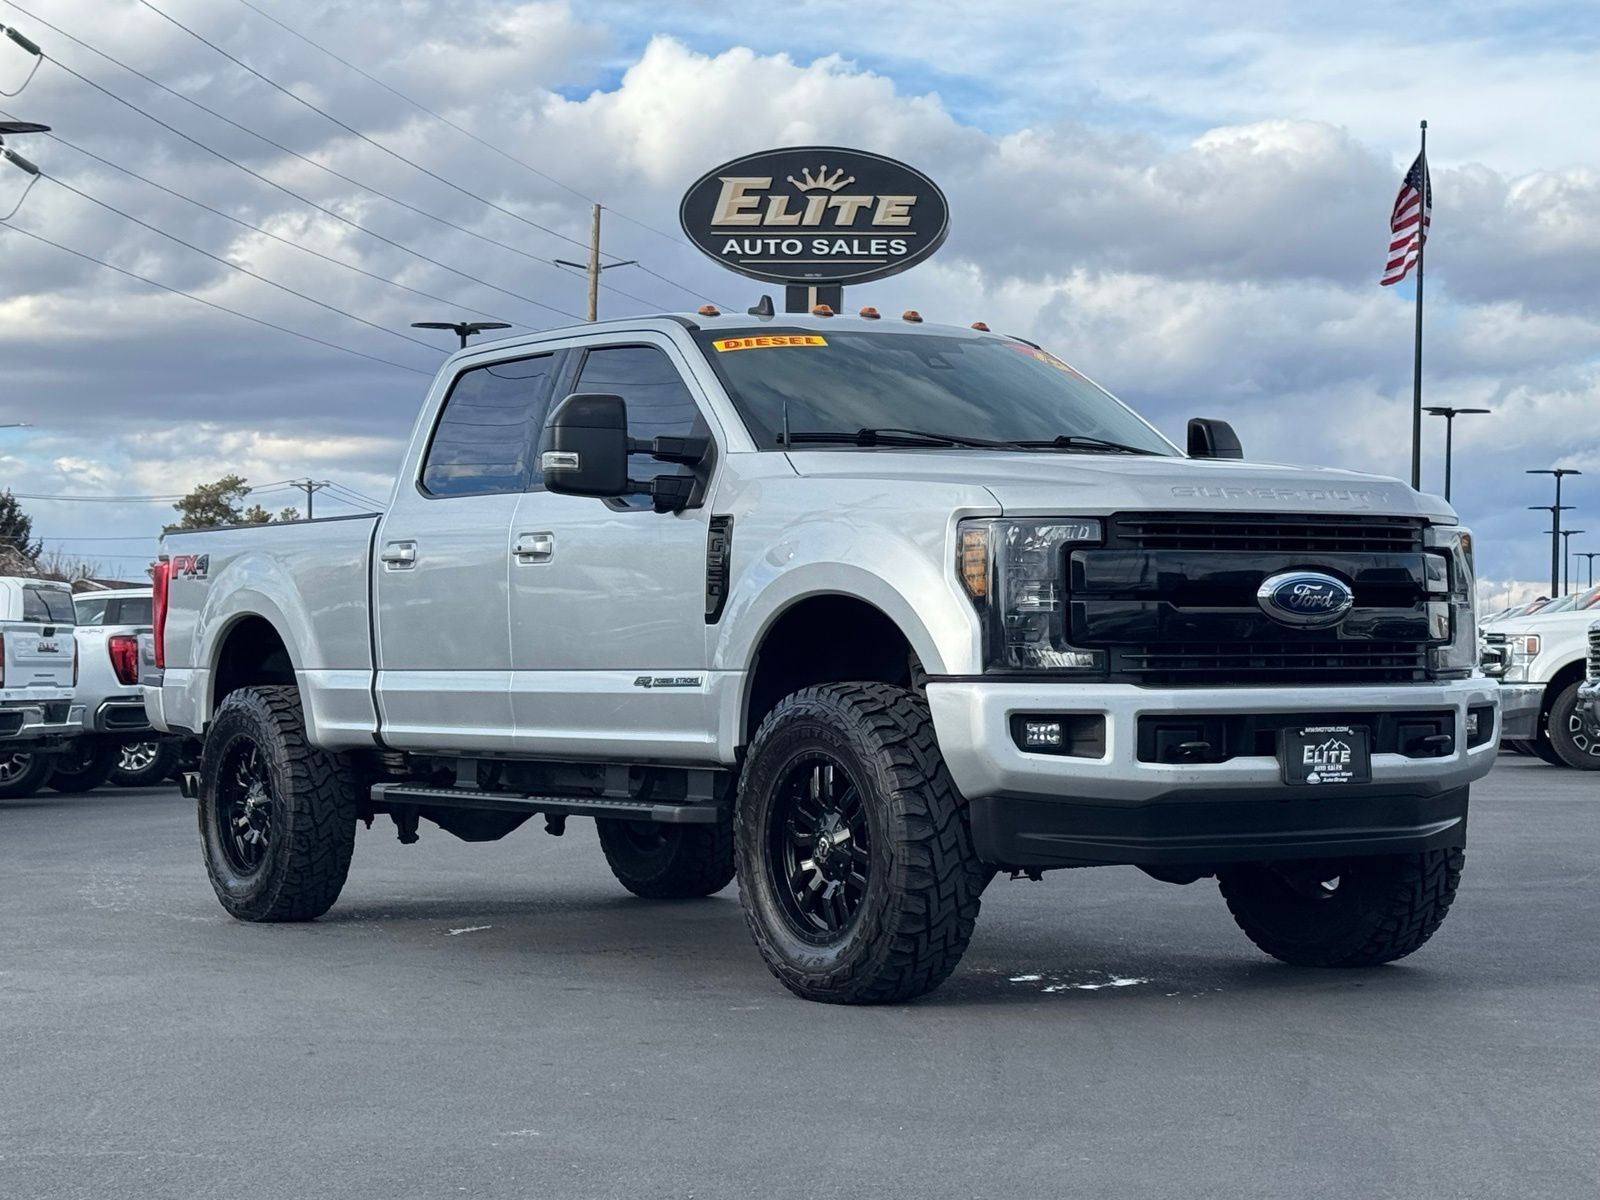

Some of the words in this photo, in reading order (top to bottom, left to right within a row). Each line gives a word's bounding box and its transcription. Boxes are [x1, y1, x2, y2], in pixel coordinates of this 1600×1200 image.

[710, 176, 918, 226] ELITE
[721, 238, 803, 255] AUTO
[811, 238, 908, 256] SALES
[723, 336, 819, 350] DIESEL
[1170, 486, 1291, 501] SUPER
[171, 554, 209, 580] FX4
[1289, 583, 1334, 608] Ford
[1303, 745, 1350, 764] ELITE
